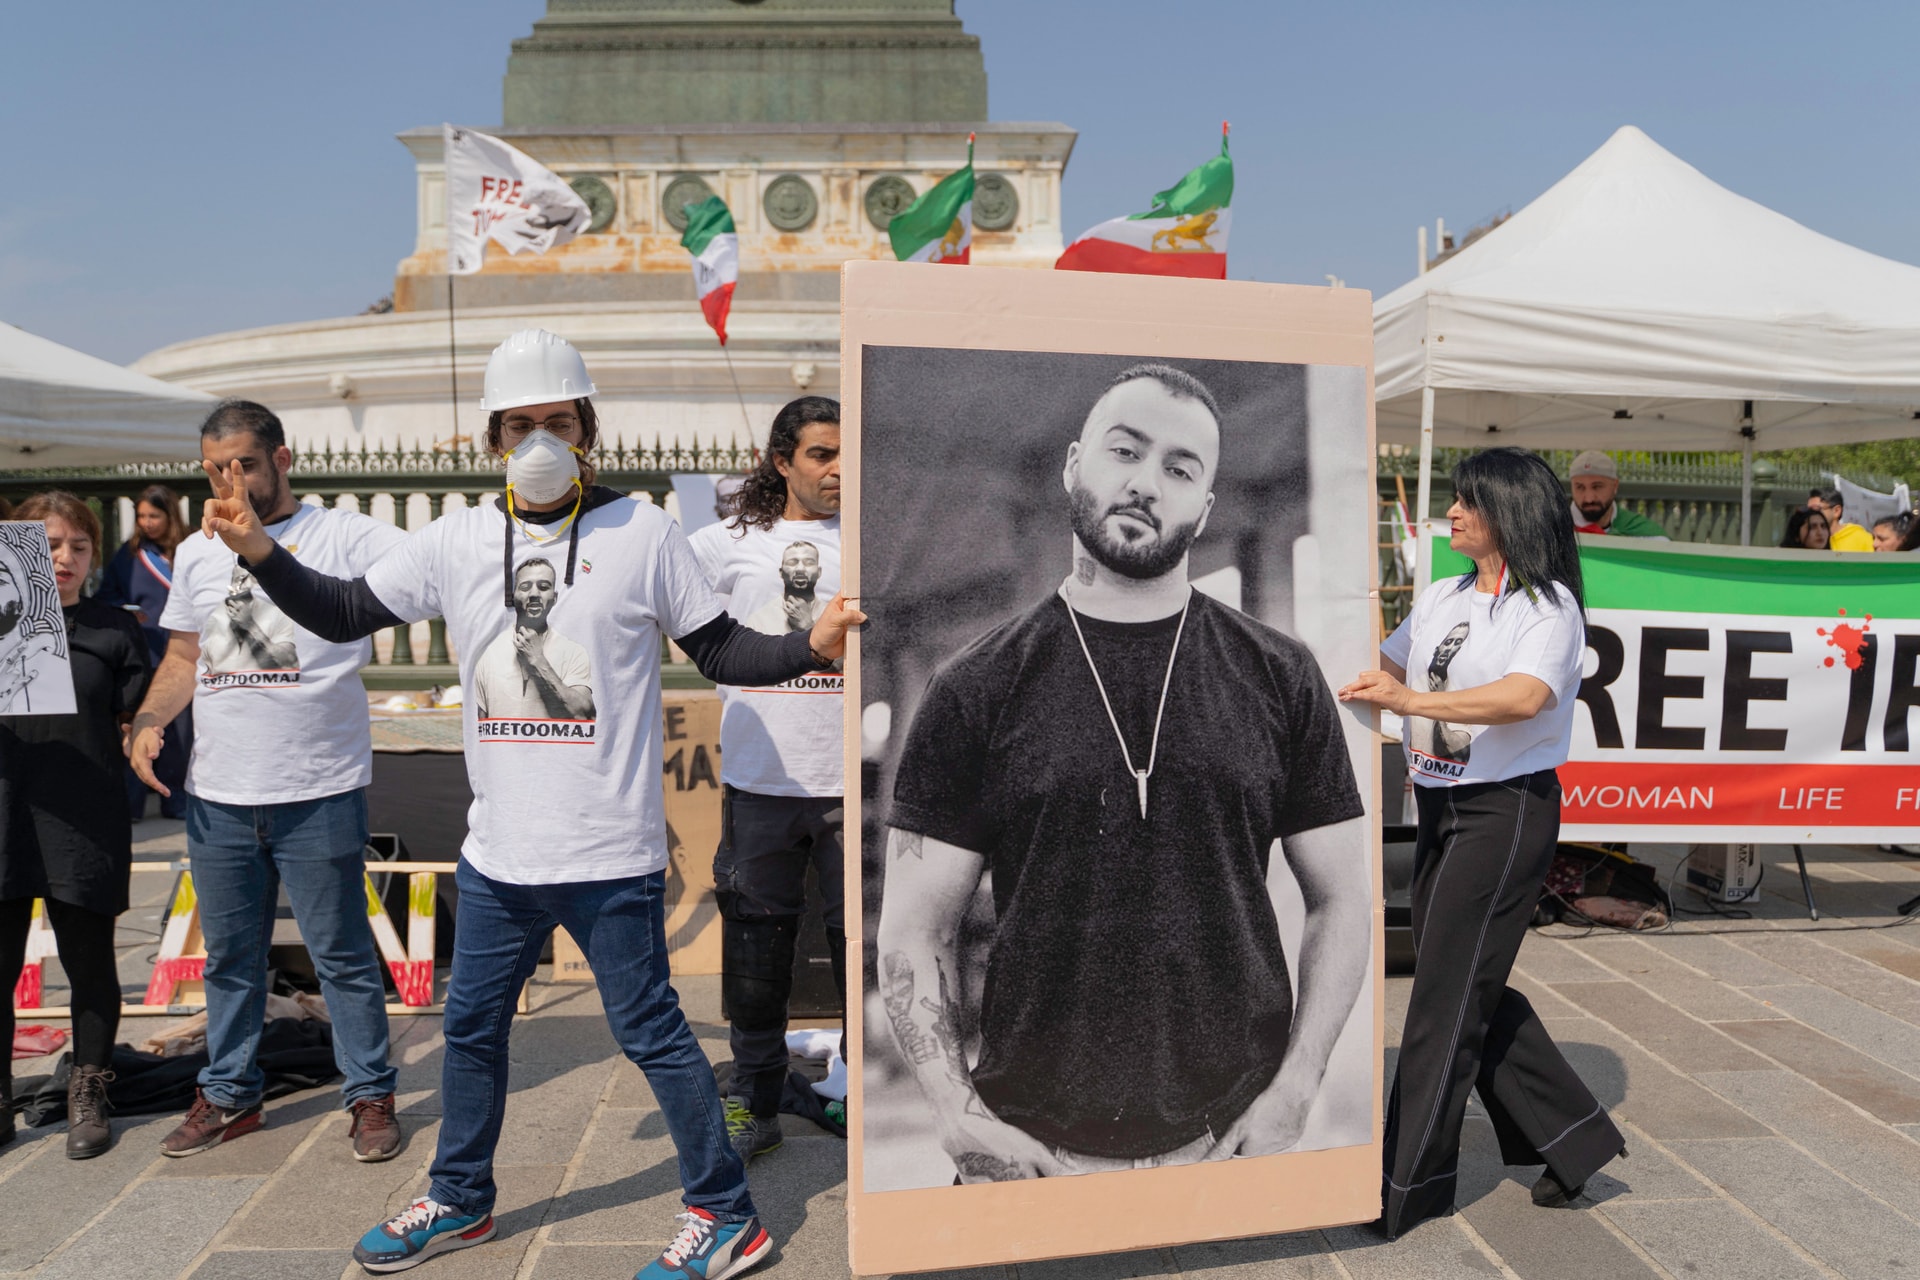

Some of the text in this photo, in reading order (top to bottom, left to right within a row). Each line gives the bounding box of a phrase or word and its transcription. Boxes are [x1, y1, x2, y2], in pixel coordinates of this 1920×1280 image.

[1576, 624, 1793, 751] REE
[1562, 785, 1714, 810] WOMAN
[1778, 787, 1845, 810] LIFE
